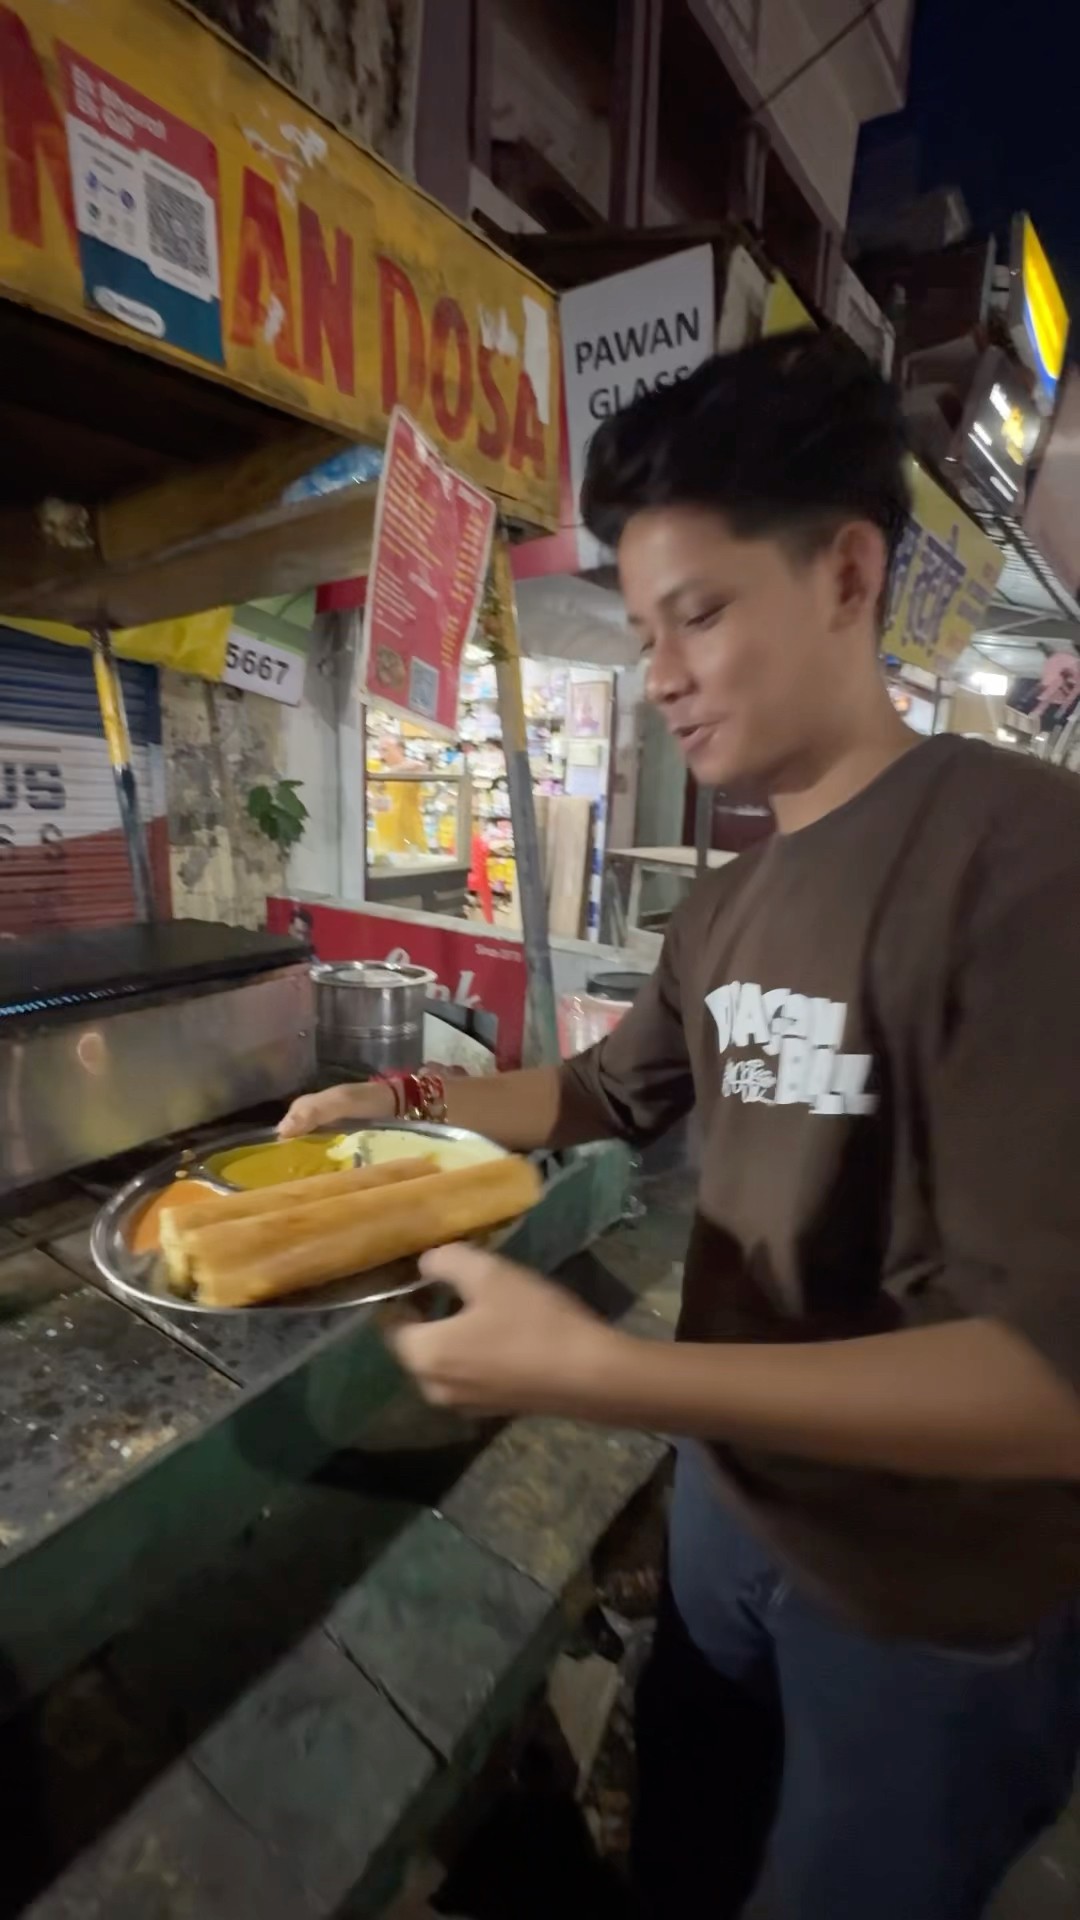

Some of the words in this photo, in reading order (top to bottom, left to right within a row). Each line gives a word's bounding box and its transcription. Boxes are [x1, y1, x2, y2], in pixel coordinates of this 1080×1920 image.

[376, 254, 548, 480] DOSA
[575, 306, 699, 374] PAWAN
[225, 641, 290, 685] 5667
